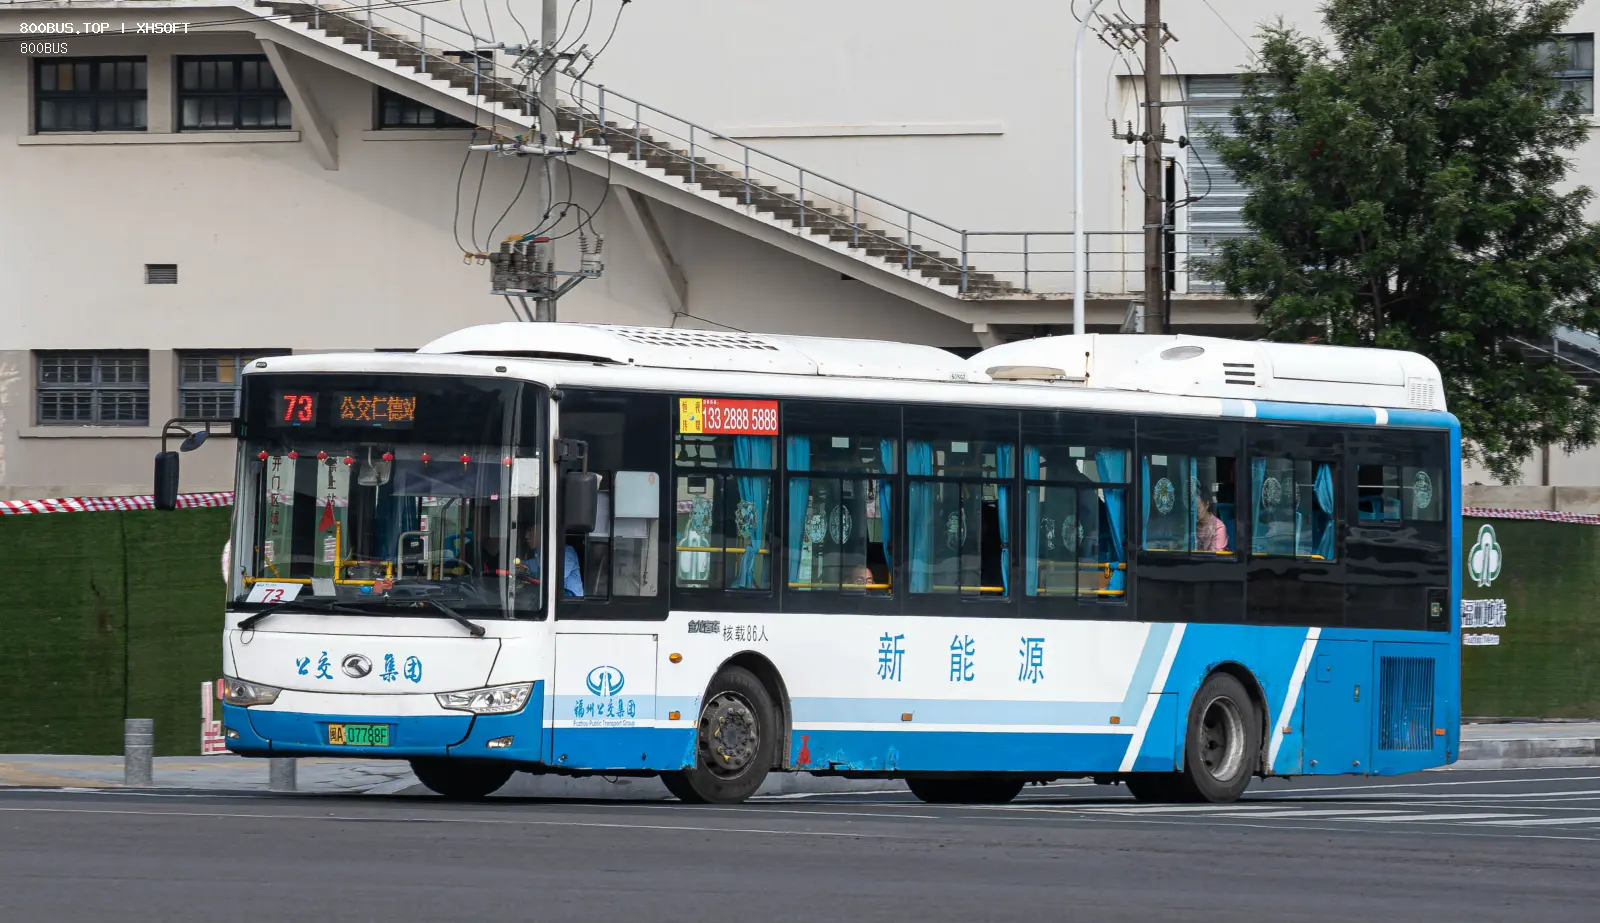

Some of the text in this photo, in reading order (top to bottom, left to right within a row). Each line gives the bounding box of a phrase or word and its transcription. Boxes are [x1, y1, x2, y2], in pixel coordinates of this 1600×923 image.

[283, 395, 313, 422] 73
[702, 406, 777, 431] 133 2888 5888
[261, 588, 285, 604] 73
[722, 624, 769, 642] 核载86人
[295, 651, 424, 684] 公交 集团
[877, 631, 1046, 685] 新能源
[572, 698, 637, 719] 福州公交集团
